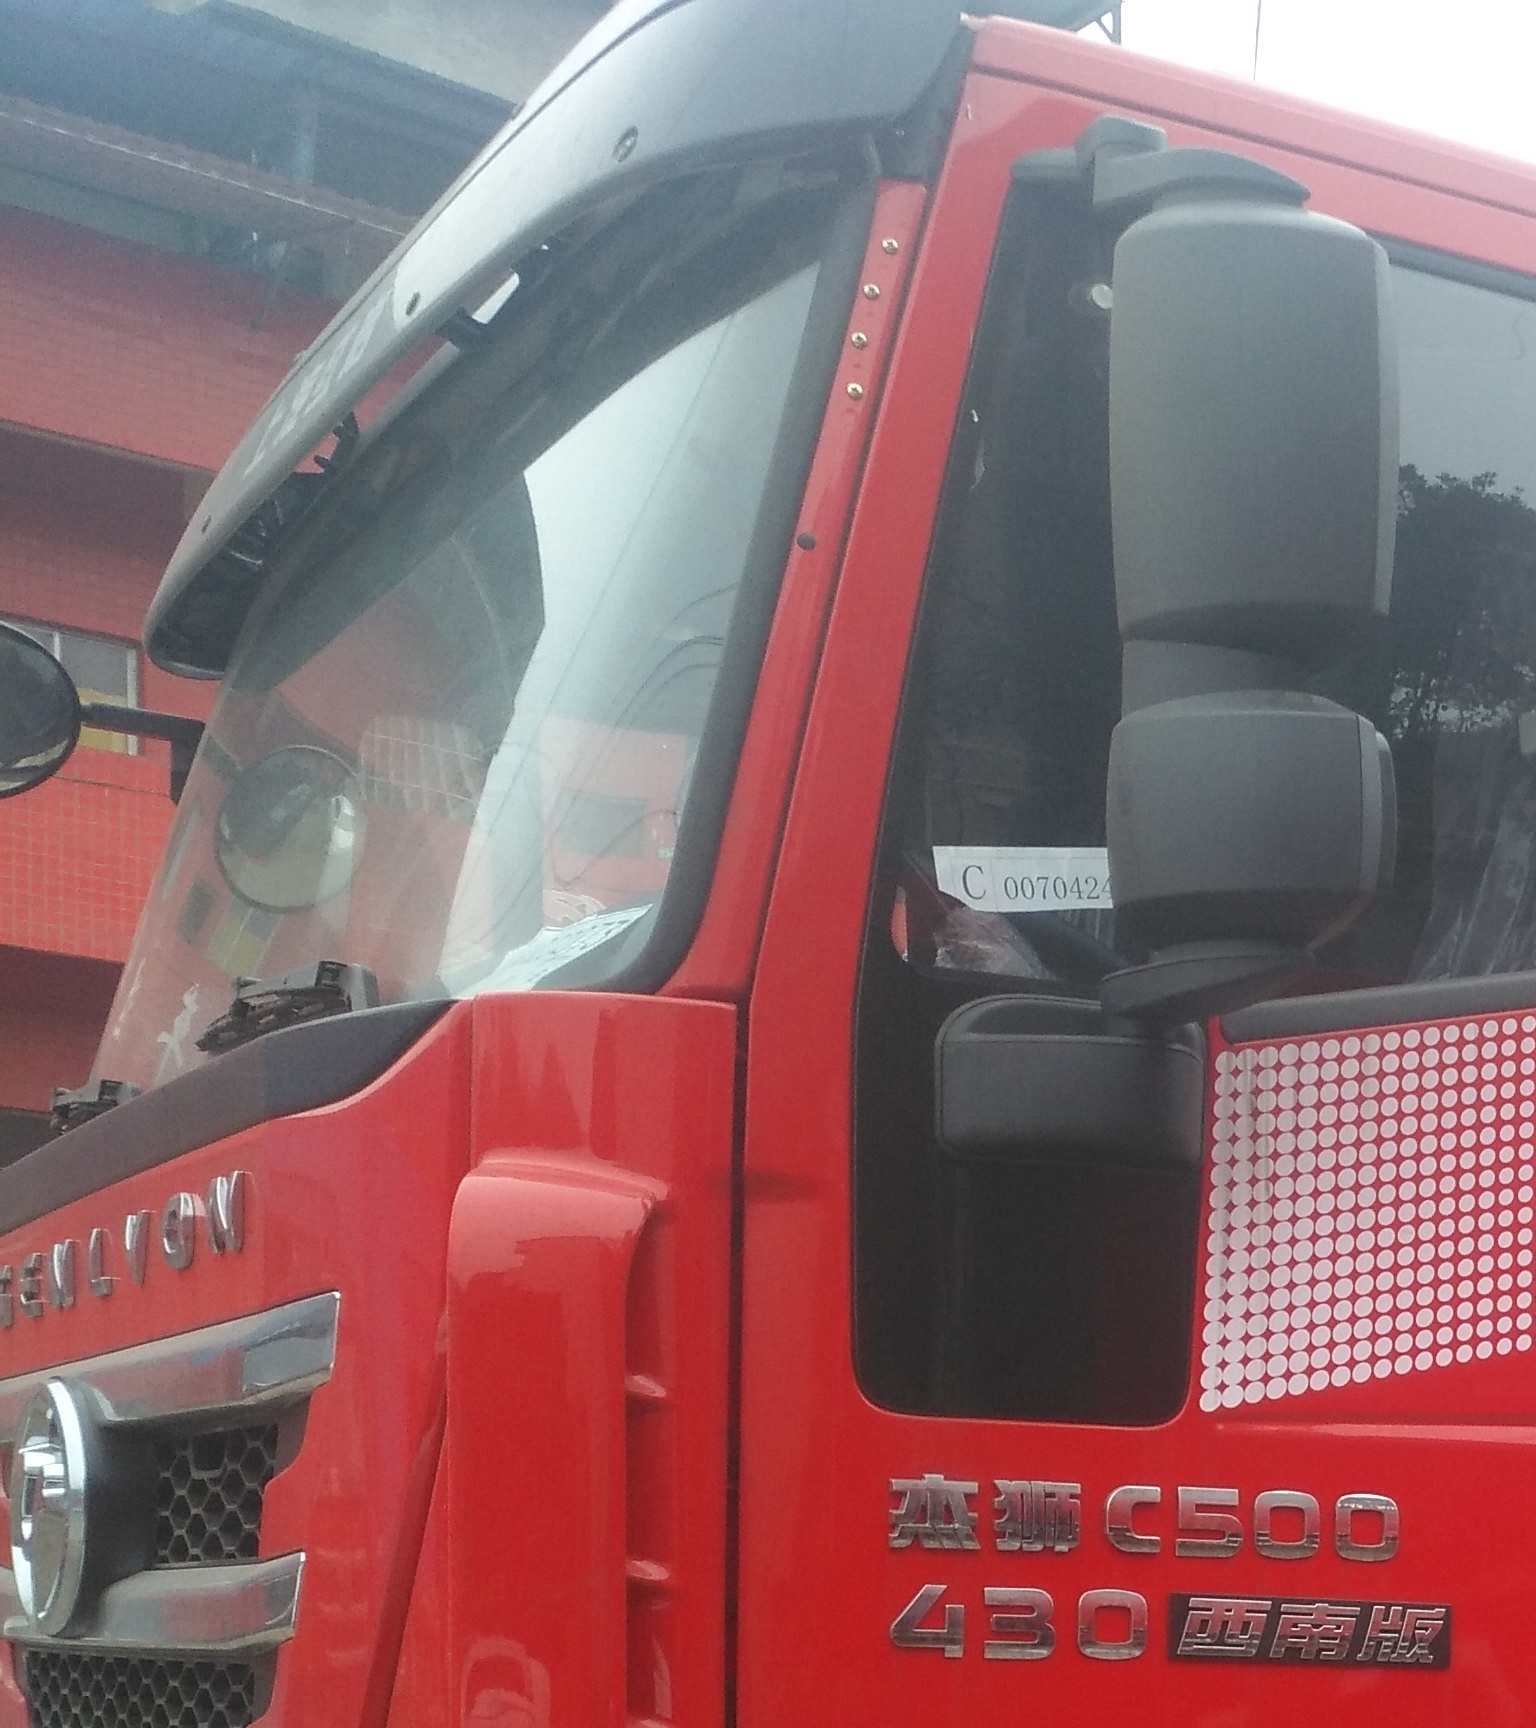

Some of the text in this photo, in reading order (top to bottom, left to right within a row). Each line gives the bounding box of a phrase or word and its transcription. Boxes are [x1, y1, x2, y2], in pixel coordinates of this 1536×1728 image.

[961, 864, 987, 900] C
[887, 1473, 1401, 1562] 杰狮 C500
[888, 1583, 1448, 1664] 430 西南版
